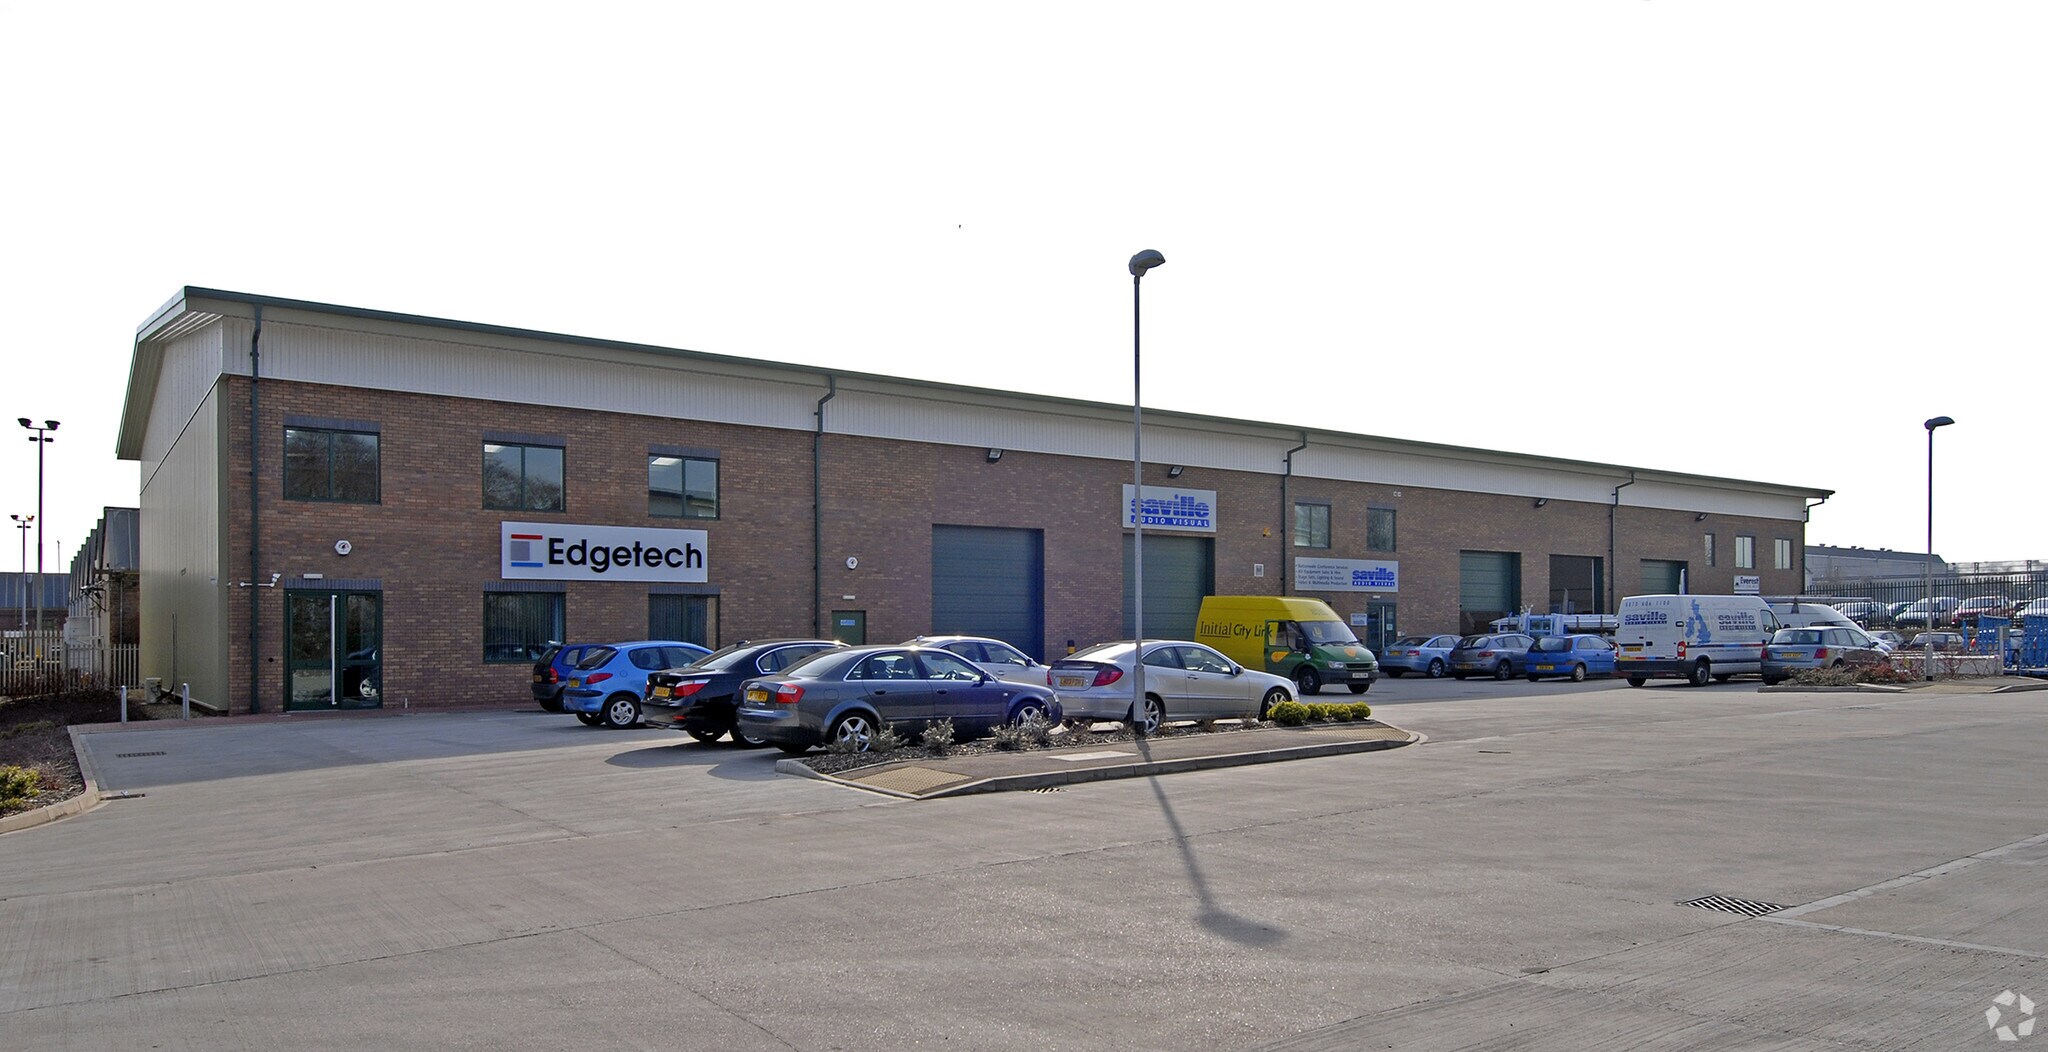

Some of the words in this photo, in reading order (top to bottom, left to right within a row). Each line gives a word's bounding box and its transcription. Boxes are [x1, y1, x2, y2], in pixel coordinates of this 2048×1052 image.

[1133, 517, 1166, 525] UDIO
[1172, 518, 1208, 527] VISUAL
[548, 537, 702, 573] Edgetech
[1352, 567, 1394, 580] saville
[1625, 611, 1667, 621] saville
[1718, 611, 1755, 625] saville
[1200, 621, 1232, 636] Initial
[1233, 624, 1252, 640] City
